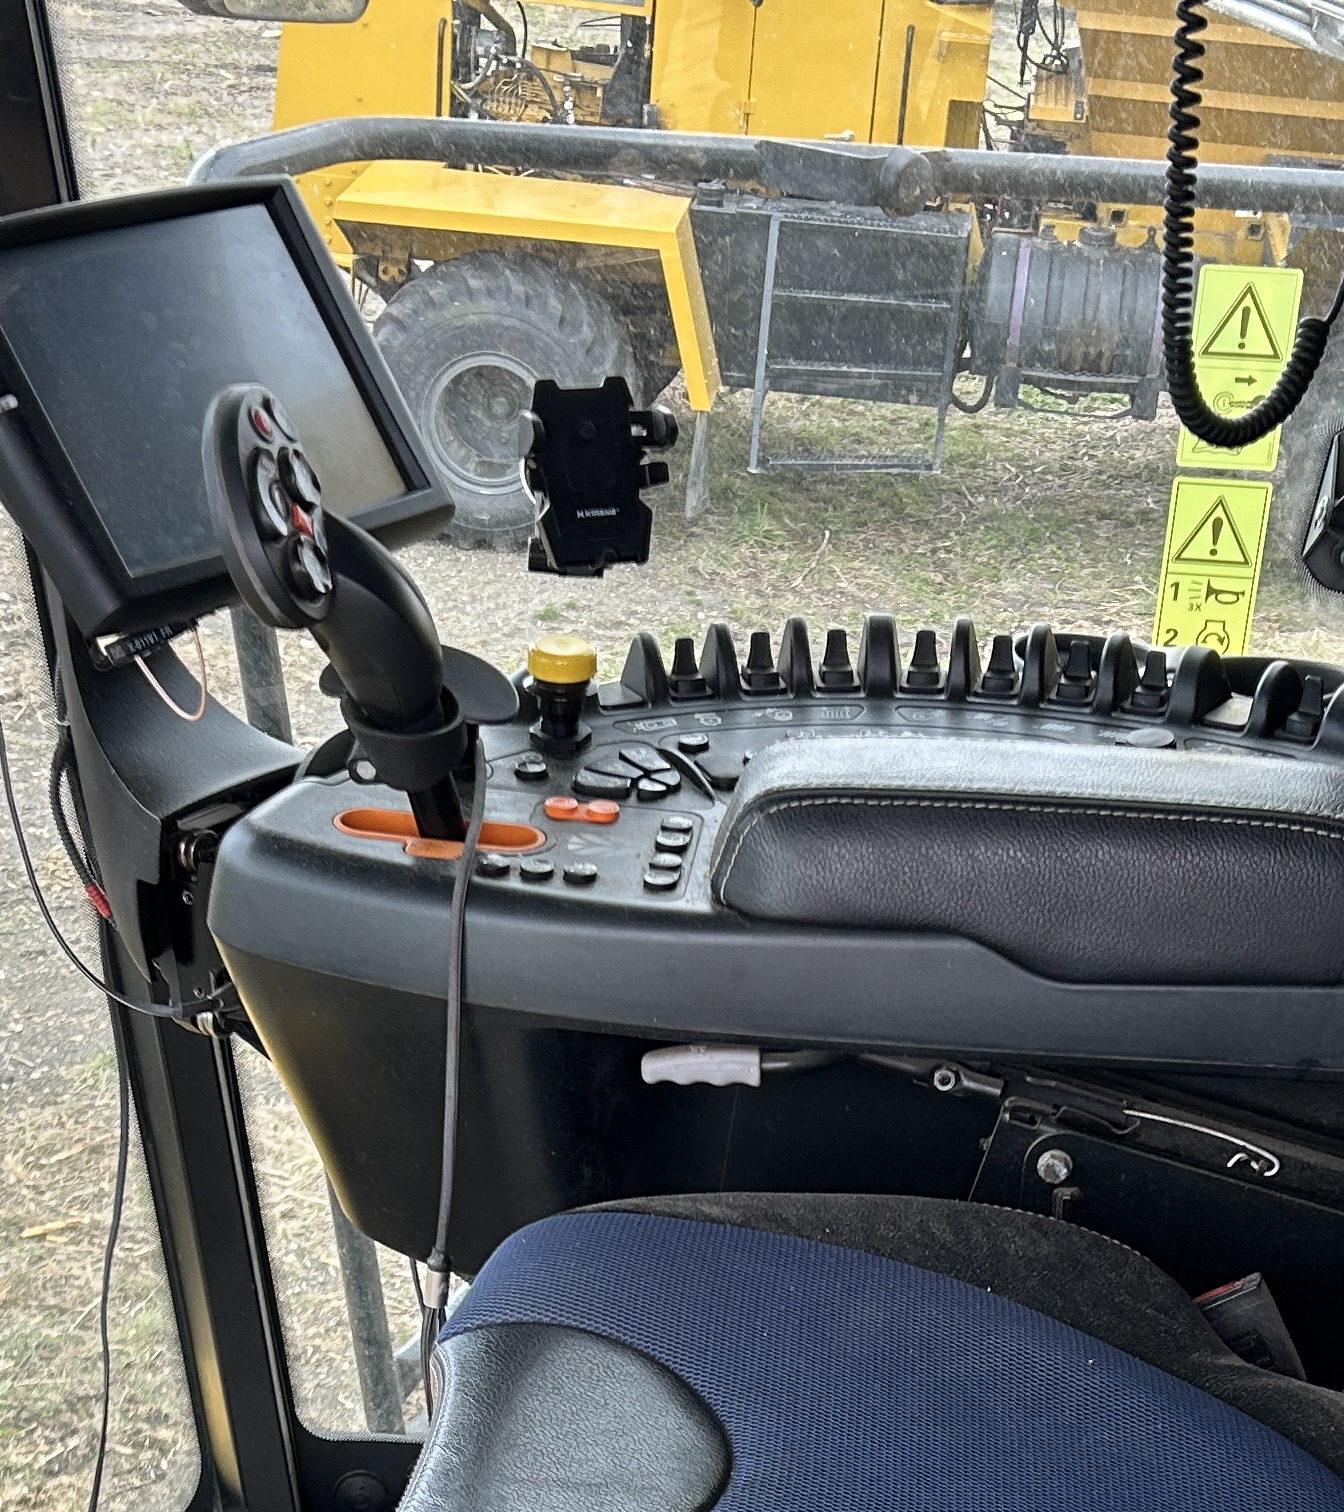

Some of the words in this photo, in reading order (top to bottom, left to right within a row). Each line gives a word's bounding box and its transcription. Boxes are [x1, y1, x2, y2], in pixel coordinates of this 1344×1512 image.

[1170, 581, 1180, 602] 1
[1188, 602, 1202, 612] 3X
[1163, 628, 1178, 647] 2
